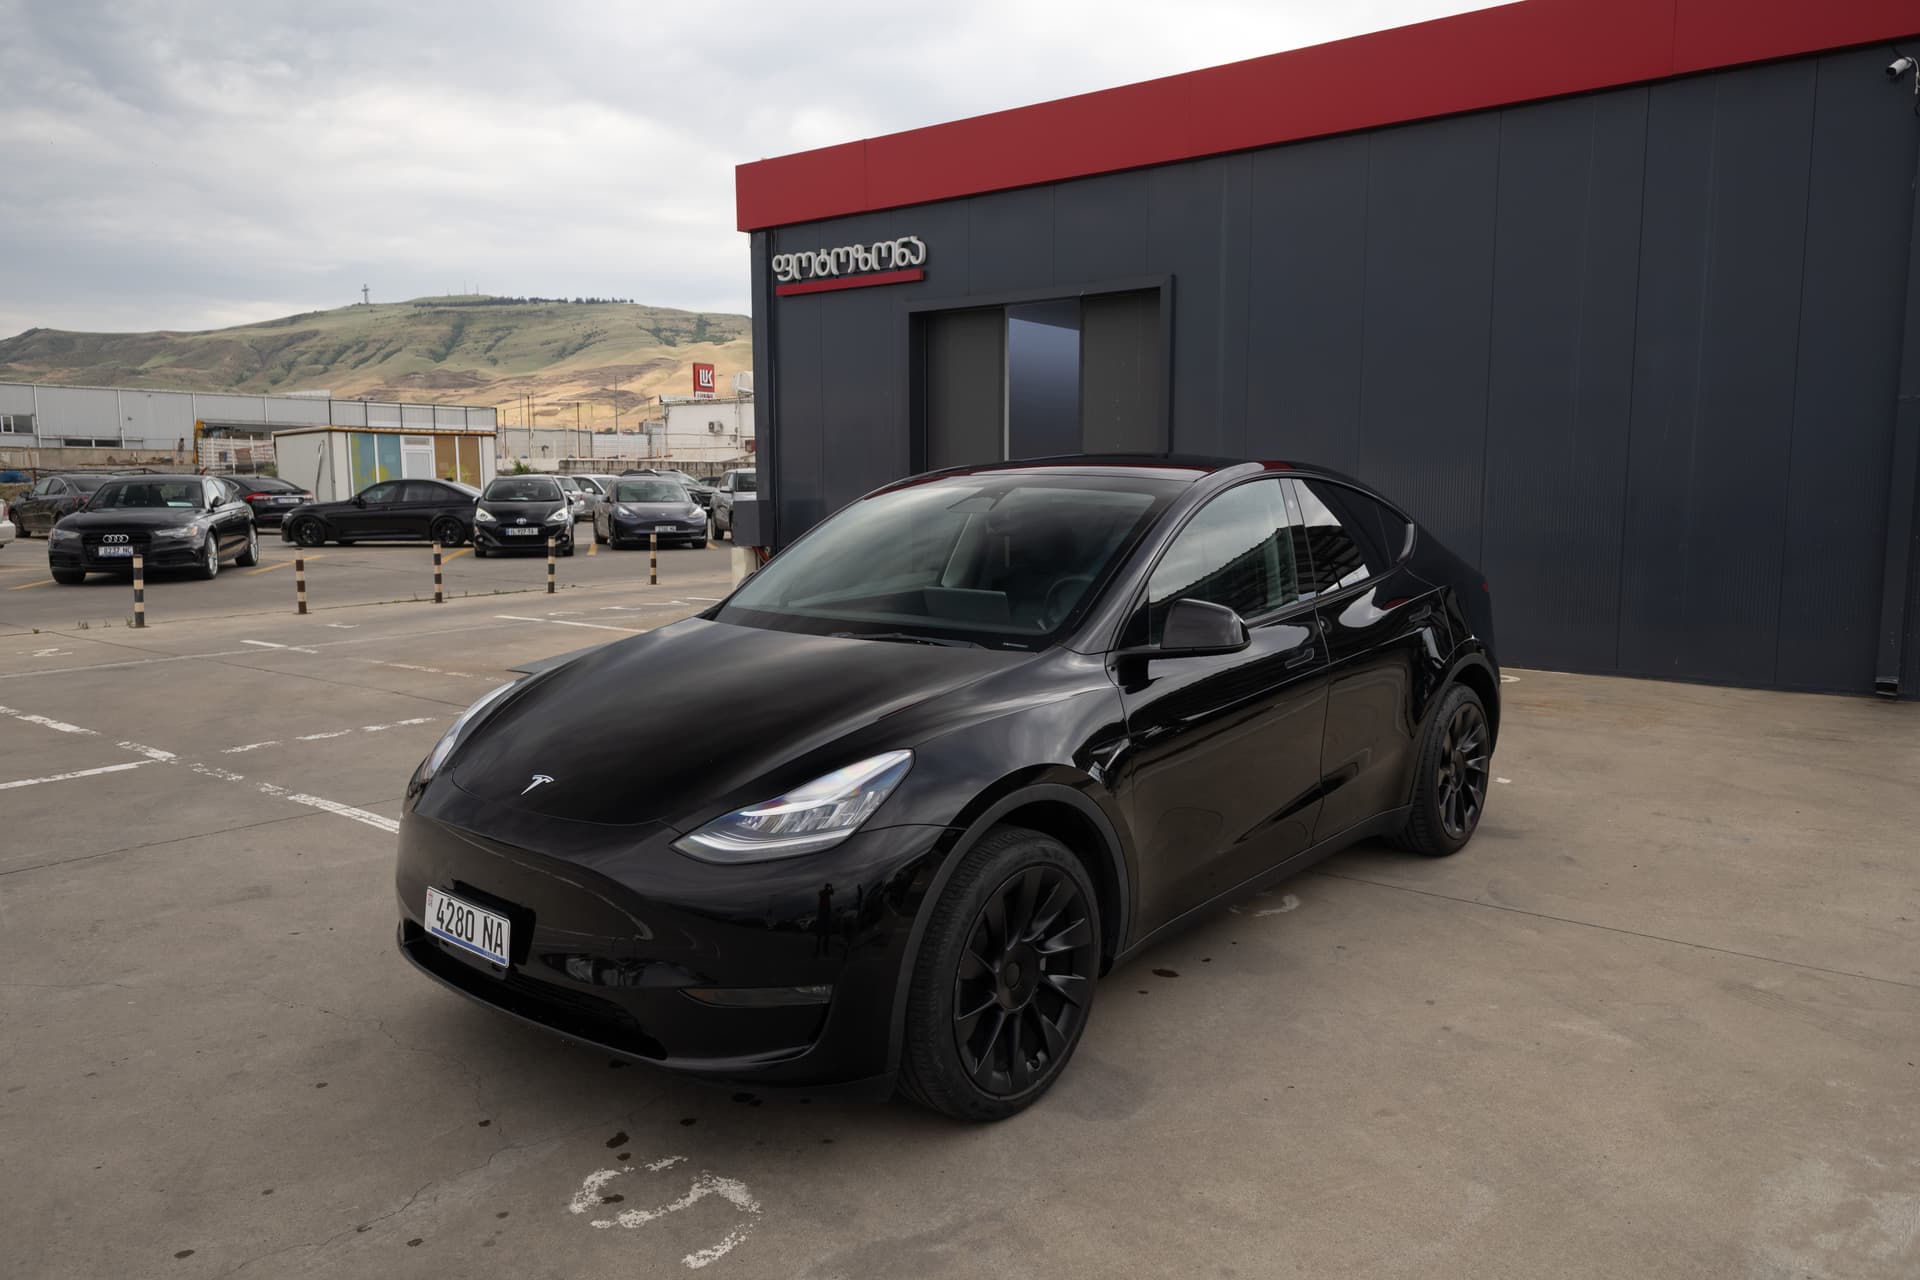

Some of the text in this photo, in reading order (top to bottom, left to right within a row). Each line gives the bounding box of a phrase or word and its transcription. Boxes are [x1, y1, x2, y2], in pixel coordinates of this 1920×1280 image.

[772, 235, 927, 281] ფოტოზონა
[436, 898, 475, 943] 4280
[482, 915, 504, 956] NA
